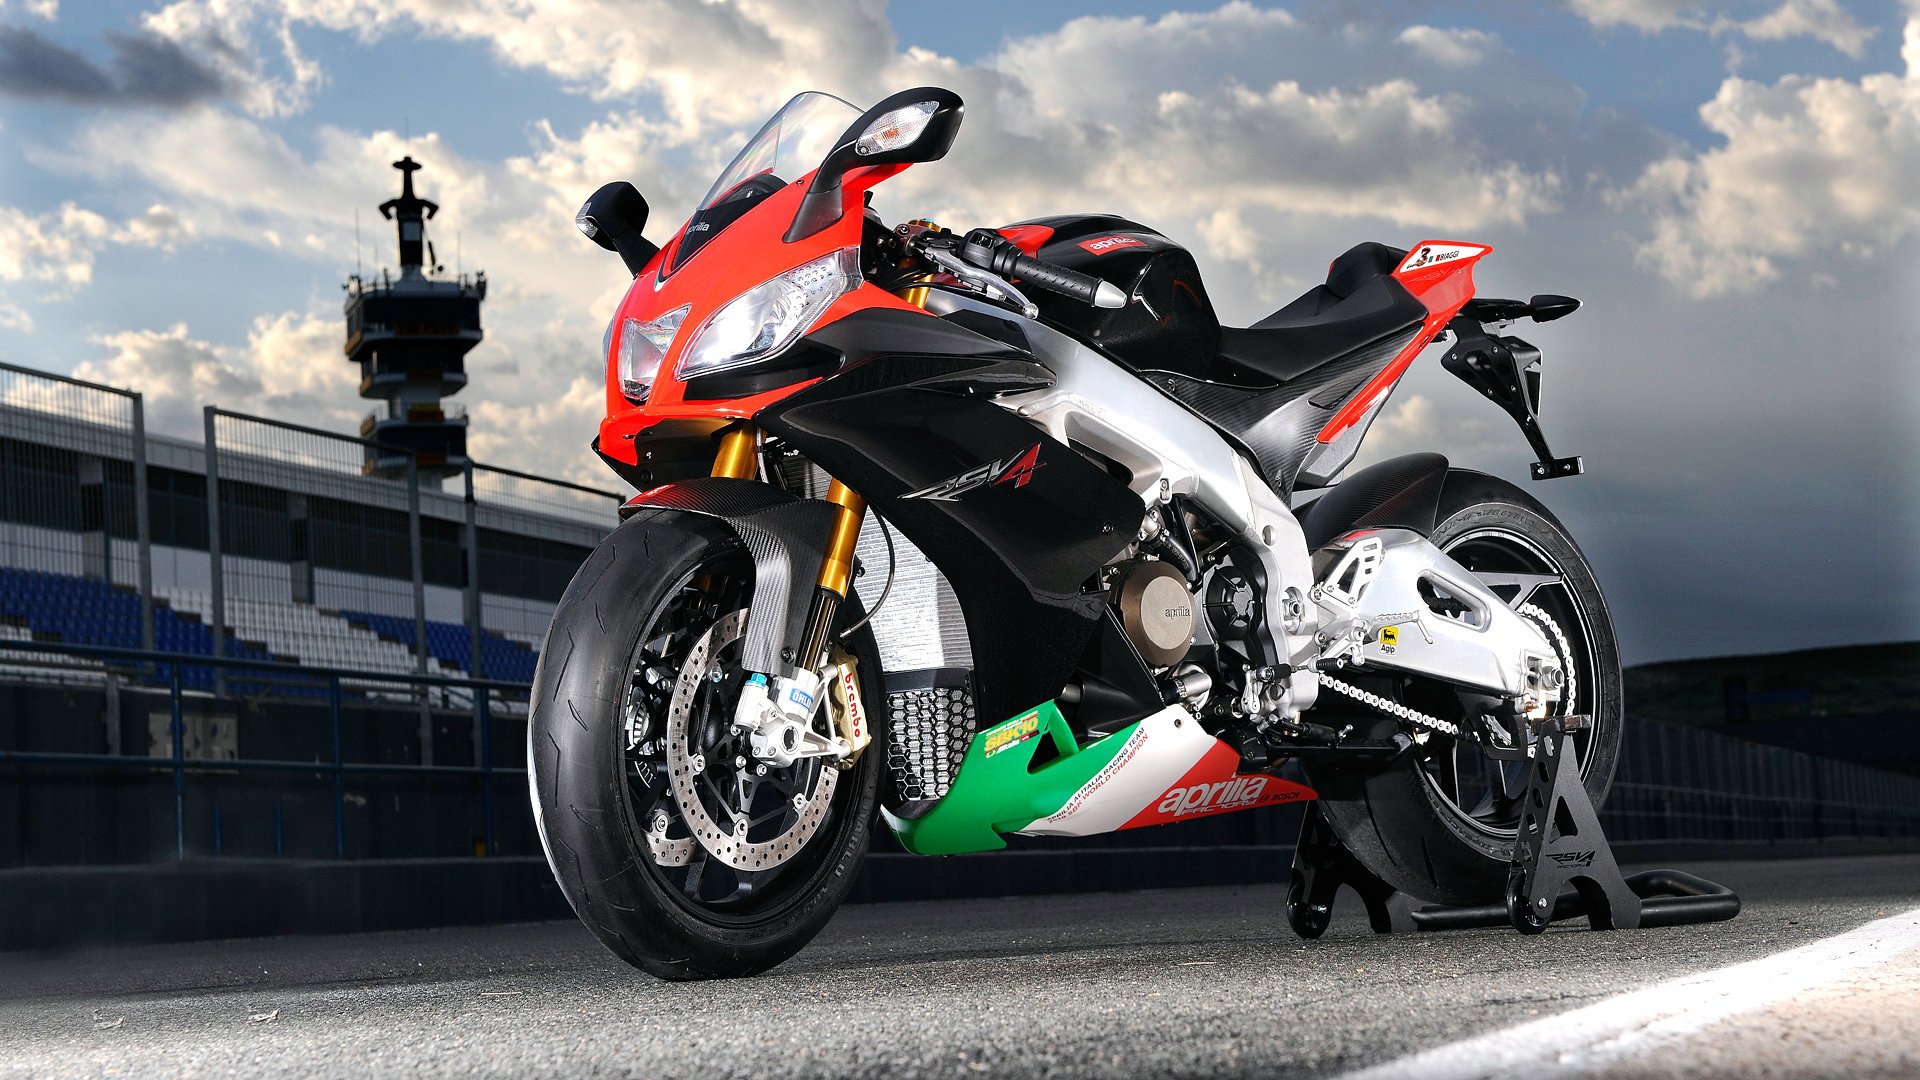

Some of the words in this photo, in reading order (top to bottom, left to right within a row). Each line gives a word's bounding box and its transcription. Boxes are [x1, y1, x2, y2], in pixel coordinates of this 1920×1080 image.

[1439, 250, 1460, 261] BIAGGI
[1164, 606, 1191, 620] aprilia
[1380, 644, 1396, 654] Agip
[844, 672, 862, 738] brembo
[1074, 774, 1103, 802] ALITALIA
[1103, 748, 1129, 776] RACING
[1128, 727, 1145, 749] TEAM
[1082, 774, 1112, 800] WORLD
[1112, 733, 1149, 775] CHAMPION
[1157, 773, 1269, 817] aprilia
[1272, 792, 1301, 801] BOSCH
[1181, 799, 1257, 816] FACTORY
[1545, 850, 1597, 867] RSV4
